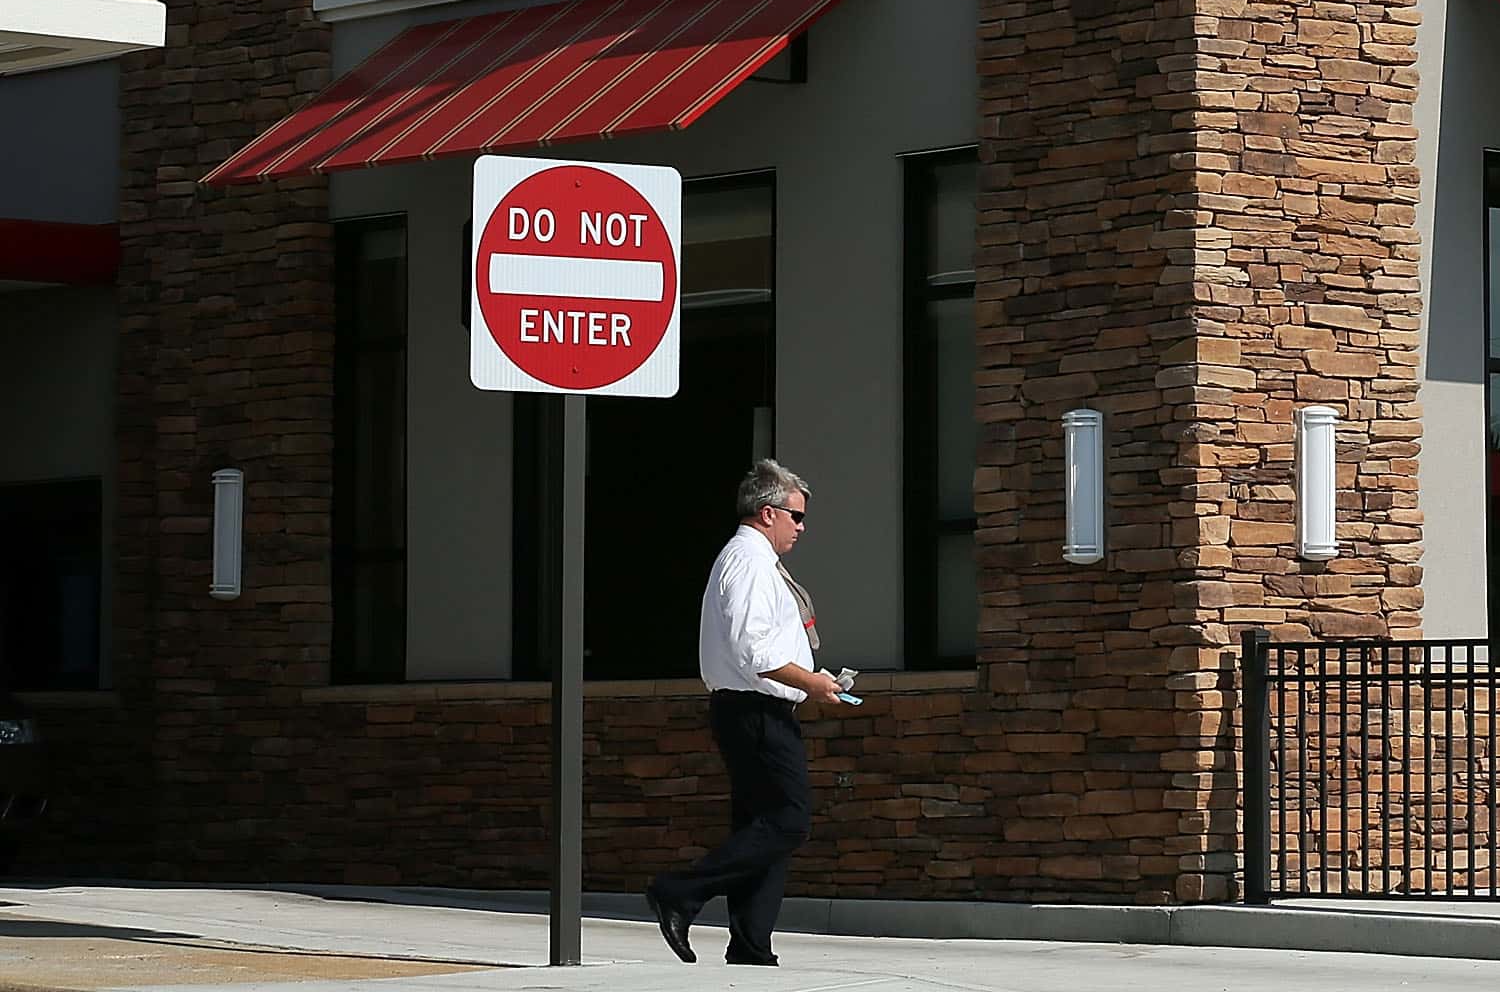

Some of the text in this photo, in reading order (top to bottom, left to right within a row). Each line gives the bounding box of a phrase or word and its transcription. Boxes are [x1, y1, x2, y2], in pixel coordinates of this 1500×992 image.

[508, 207, 649, 247] DO NOT
[520, 309, 632, 347] ENTER
